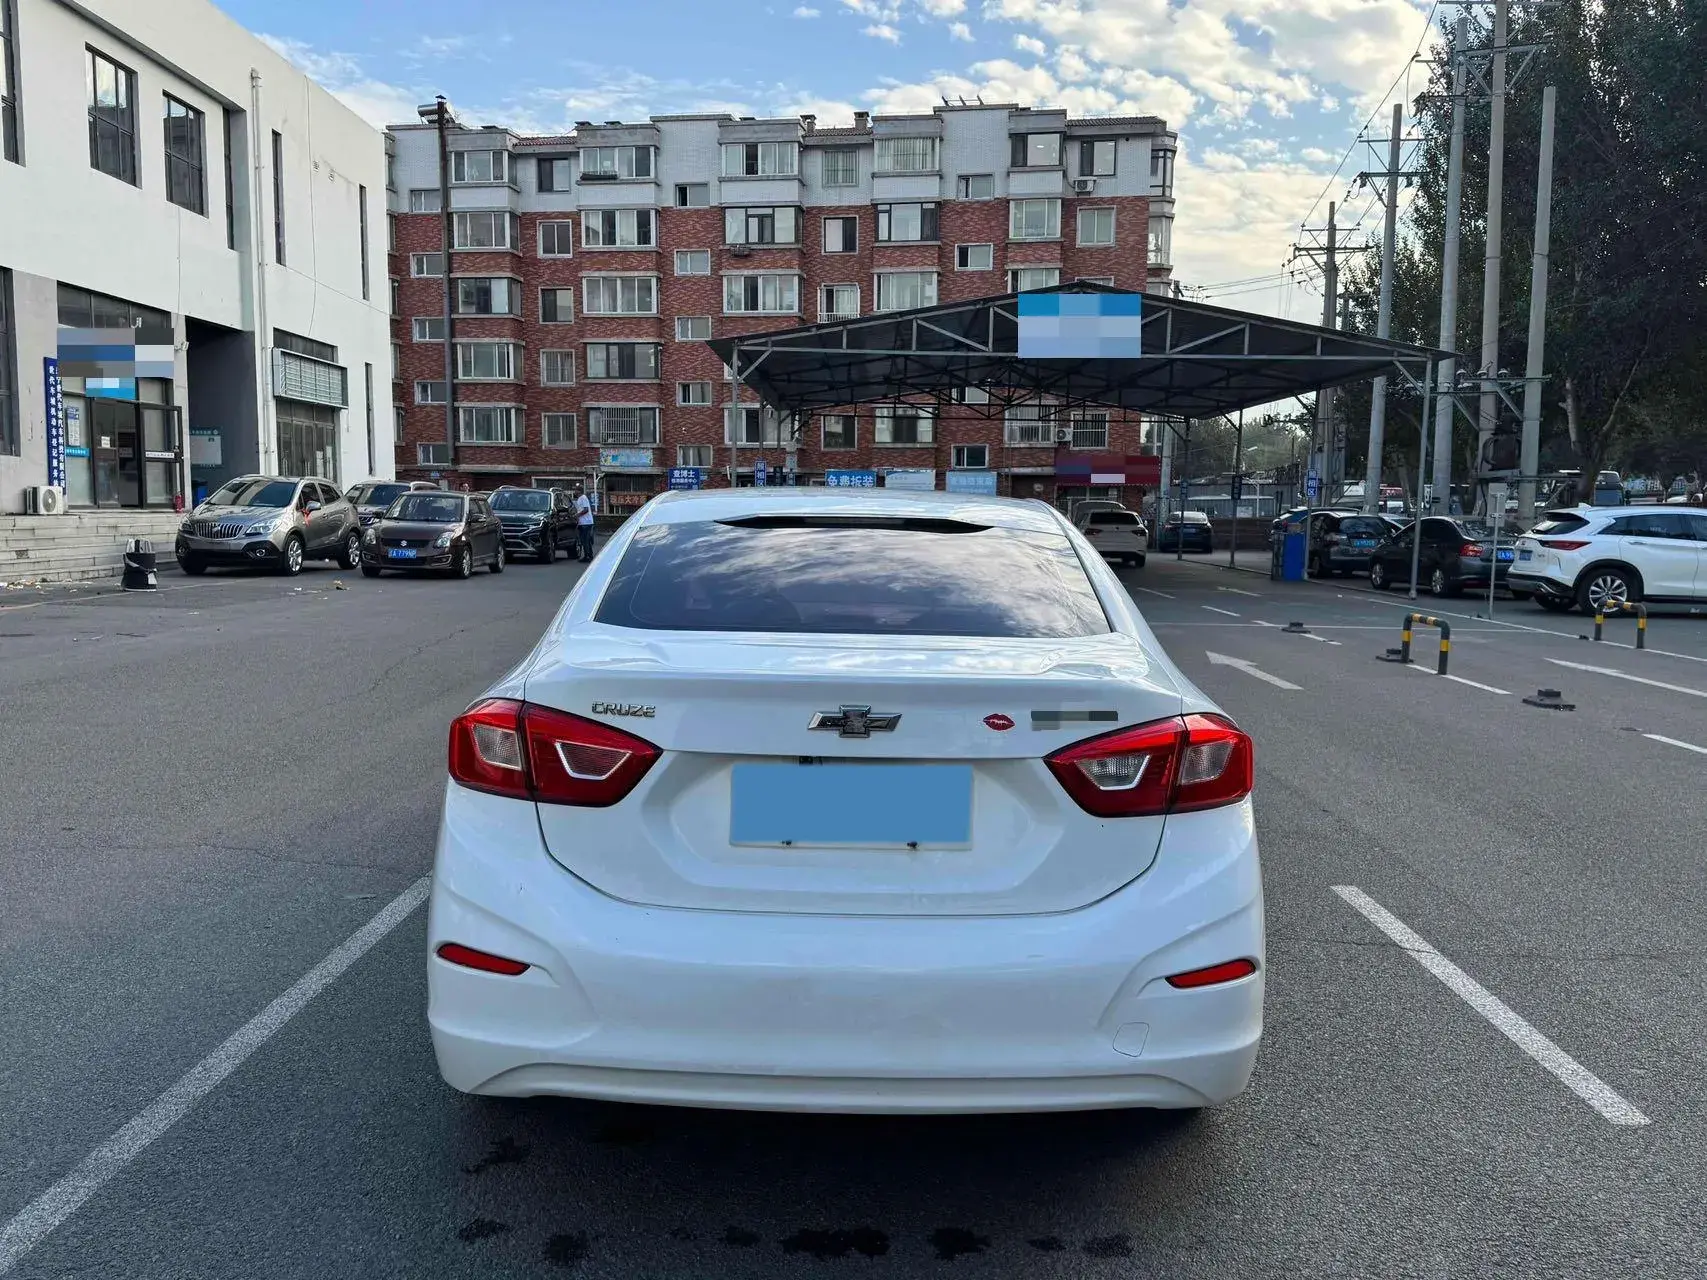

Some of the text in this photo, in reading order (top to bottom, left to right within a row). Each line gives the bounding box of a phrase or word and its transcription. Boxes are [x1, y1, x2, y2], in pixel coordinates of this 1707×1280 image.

[673, 469, 696, 478] 查博士
[827, 474, 874, 488] 免费拆装
[592, 701, 656, 718] CRUZE
